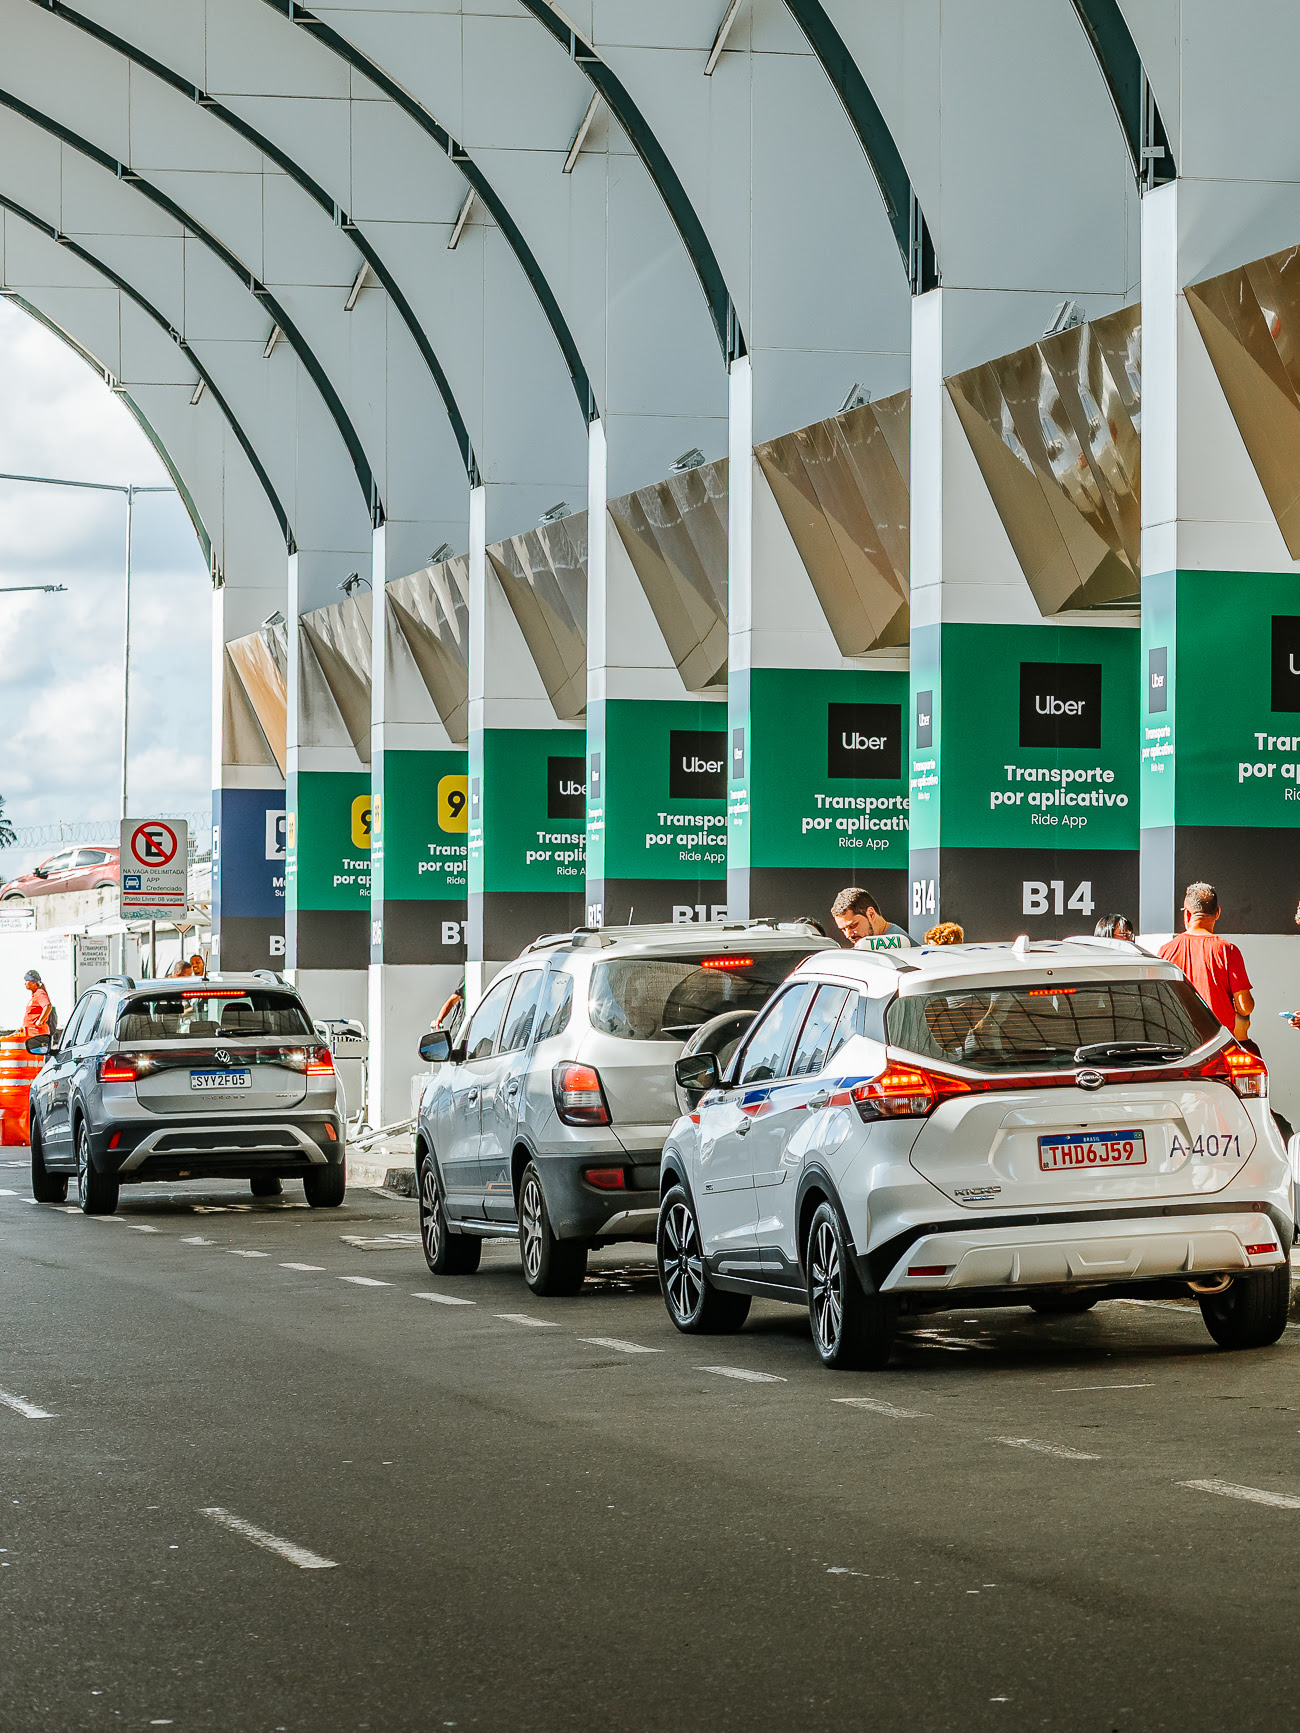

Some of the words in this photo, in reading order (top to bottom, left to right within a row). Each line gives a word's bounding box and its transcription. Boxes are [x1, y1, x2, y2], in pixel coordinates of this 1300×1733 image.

[1151, 673, 1164, 688] Uber
[1035, 696, 1085, 715] Uber
[842, 732, 887, 750] Uber
[682, 756, 724, 773] Uber
[1238, 762, 1276, 783] por
[1004, 765, 1115, 787] Transporte
[559, 781, 586, 795] Ube
[447, 790, 467, 818] 9
[990, 790, 1024, 809] por
[1028, 789, 1129, 810] aplicativo
[657, 812, 728, 830] Transpo
[802, 816, 833, 834] por
[836, 815, 909, 834] aplicativ
[1031, 814, 1058, 825] Ride
[1062, 815, 1088, 828] App
[537, 831, 586, 847] Transp
[645, 833, 674, 849] por
[676, 831, 727, 849] aplica
[839, 837, 863, 848] Ride
[866, 837, 889, 850] App
[428, 844, 467, 855] Trans
[526, 850, 552, 864] por
[679, 851, 701, 861] Ride
[704, 852, 725, 863] App
[418, 861, 442, 874] por
[557, 867, 577, 875] Ride
[334, 875, 355, 887] por
[447, 876, 465, 884] Ride
[912, 880, 935, 915] B14
[1022, 880, 1095, 916] B14
[442, 921, 468, 944] B1
[866, 936, 902, 950] TAXI
[196, 1075, 246, 1086] SYY2F05
[1049, 1141, 1134, 1166] THD6J59
[1169, 1134, 1241, 1158] A-4071
